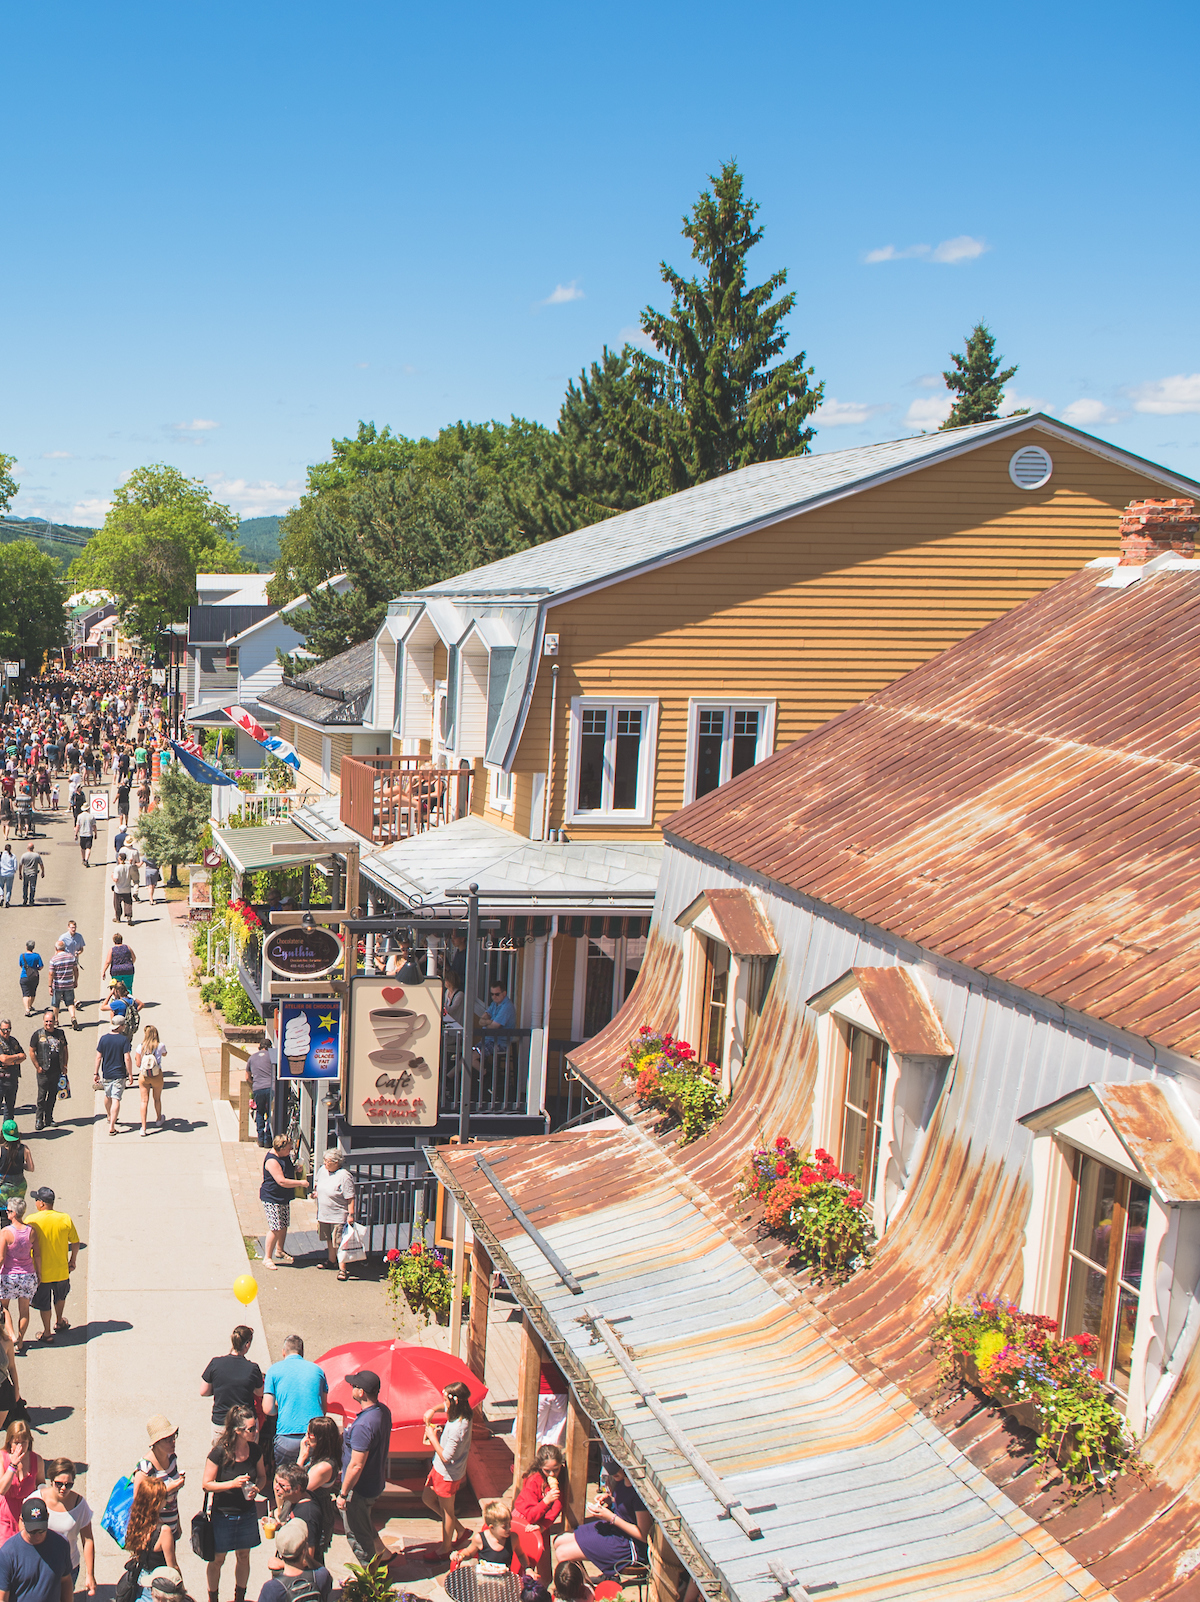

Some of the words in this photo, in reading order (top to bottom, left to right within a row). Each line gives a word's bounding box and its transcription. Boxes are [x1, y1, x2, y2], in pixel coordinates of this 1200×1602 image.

[272, 945, 316, 961] Cynthia
[375, 1070, 412, 1096] Café
[361, 1094, 409, 1107] Arômes
[412, 1097, 424, 1107] et
